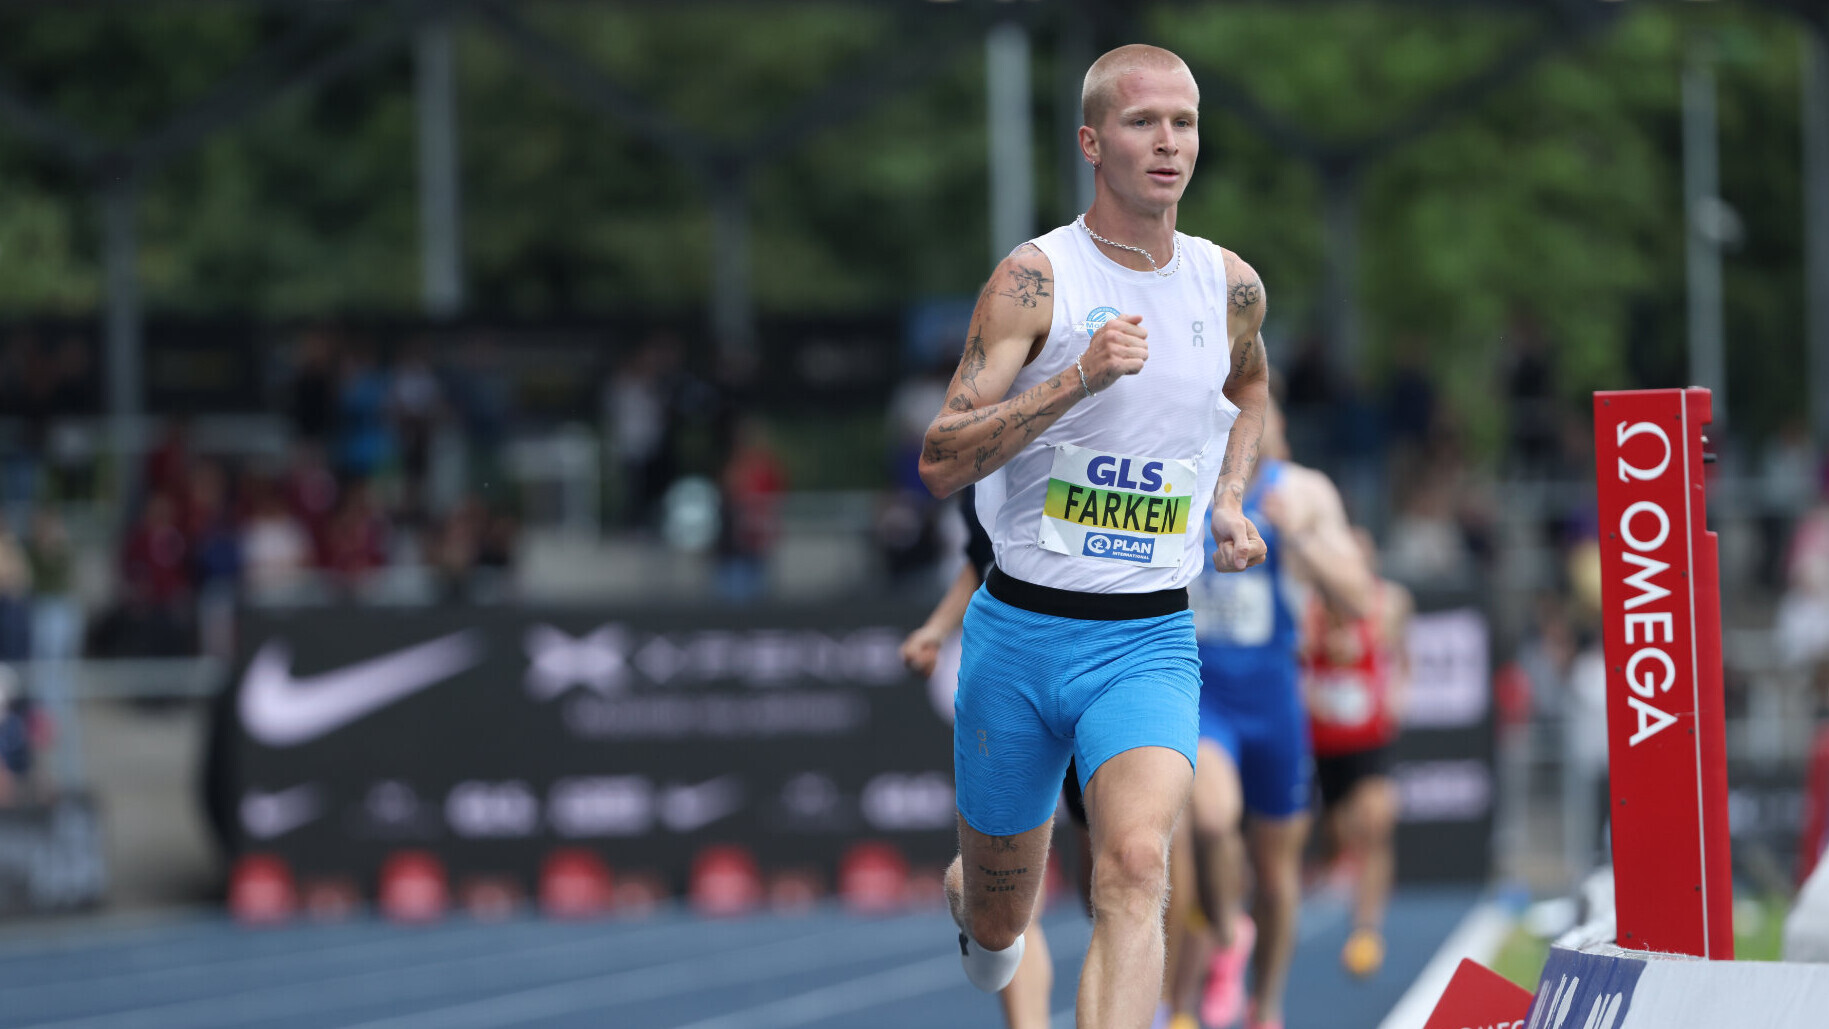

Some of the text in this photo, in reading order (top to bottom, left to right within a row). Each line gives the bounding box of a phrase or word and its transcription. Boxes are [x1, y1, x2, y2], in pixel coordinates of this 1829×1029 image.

[1064, 485, 1179, 533] FARKEN
[1112, 551, 1150, 560] INTERNATIONAL
[1113, 539, 1152, 554] PLAN
[1619, 501, 1679, 747] OMEGA
